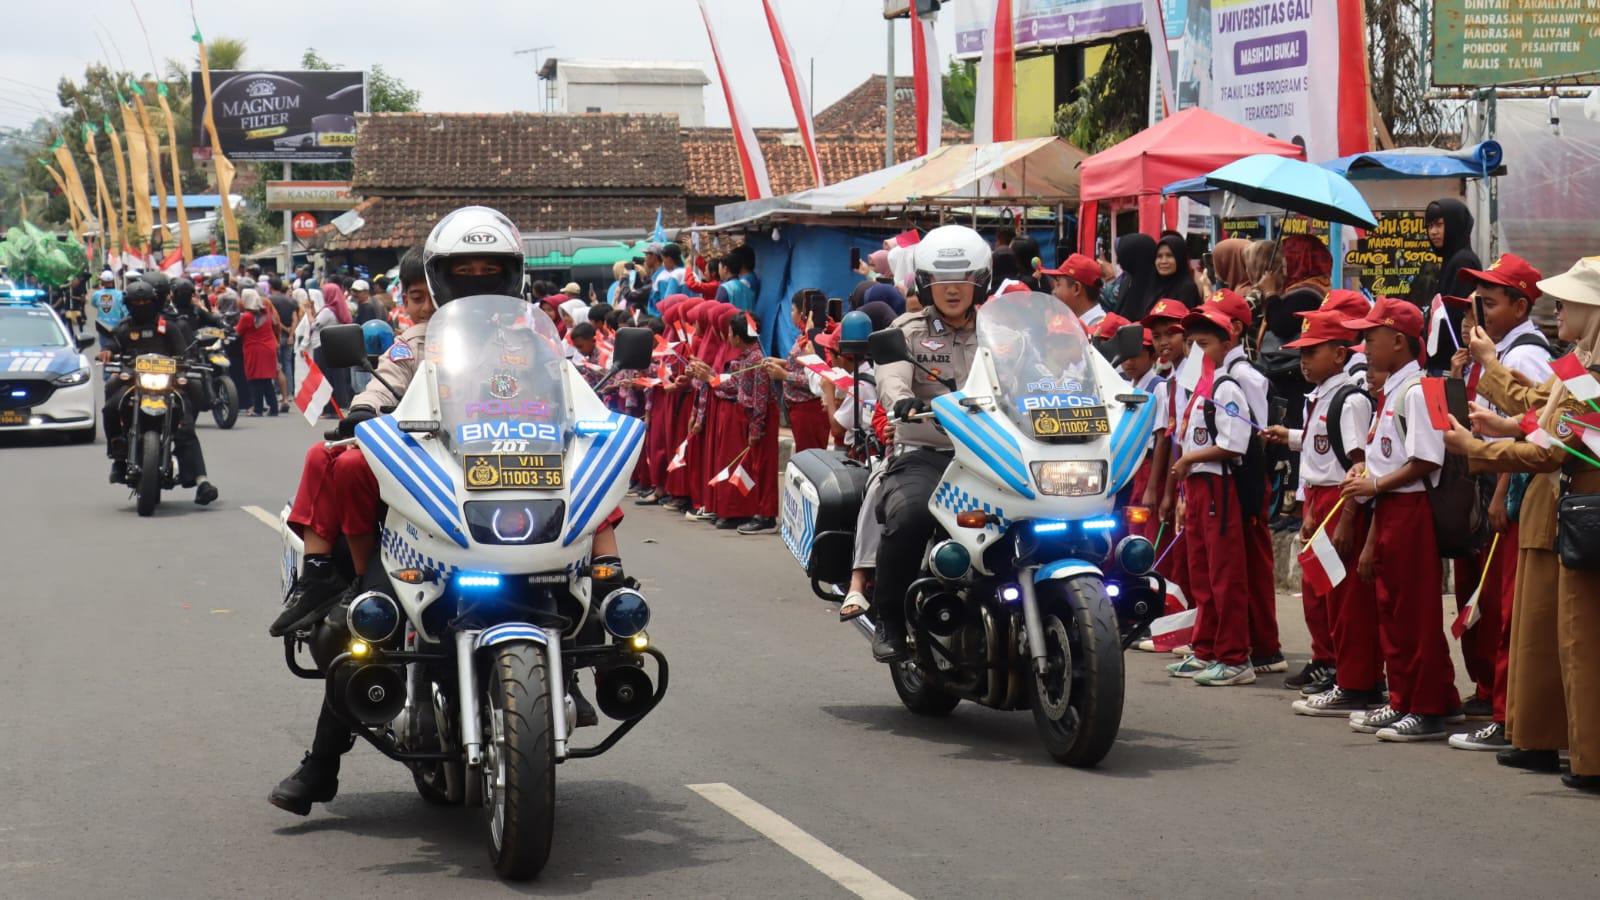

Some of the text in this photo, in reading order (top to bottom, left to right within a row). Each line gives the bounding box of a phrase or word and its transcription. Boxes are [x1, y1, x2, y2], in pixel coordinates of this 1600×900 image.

[1218, 0, 1312, 34] UNIVERSITAS GAL
[1465, 13, 1600, 25] MADRASAH TSANAWIYAH
[1464, 28, 1522, 39] MADRASAH
[1533, 27, 1571, 38] ALIYAH
[1240, 40, 1299, 66] MASIH DI BUKA!
[1463, 42, 1580, 54] PONDOK PESANTREN
[1463, 58, 1500, 69] MAJLIS
[1266, 78, 1301, 95] PROGRAM
[222, 95, 300, 118] MAGNUM
[241, 113, 289, 129] FILTER
[1346, 251, 1391, 265] CIMOL
[1024, 396, 1095, 410] BM-03
[1071, 409, 1093, 418] VIII
[462, 422, 556, 441] BM-02
[519, 456, 545, 467] VIII
